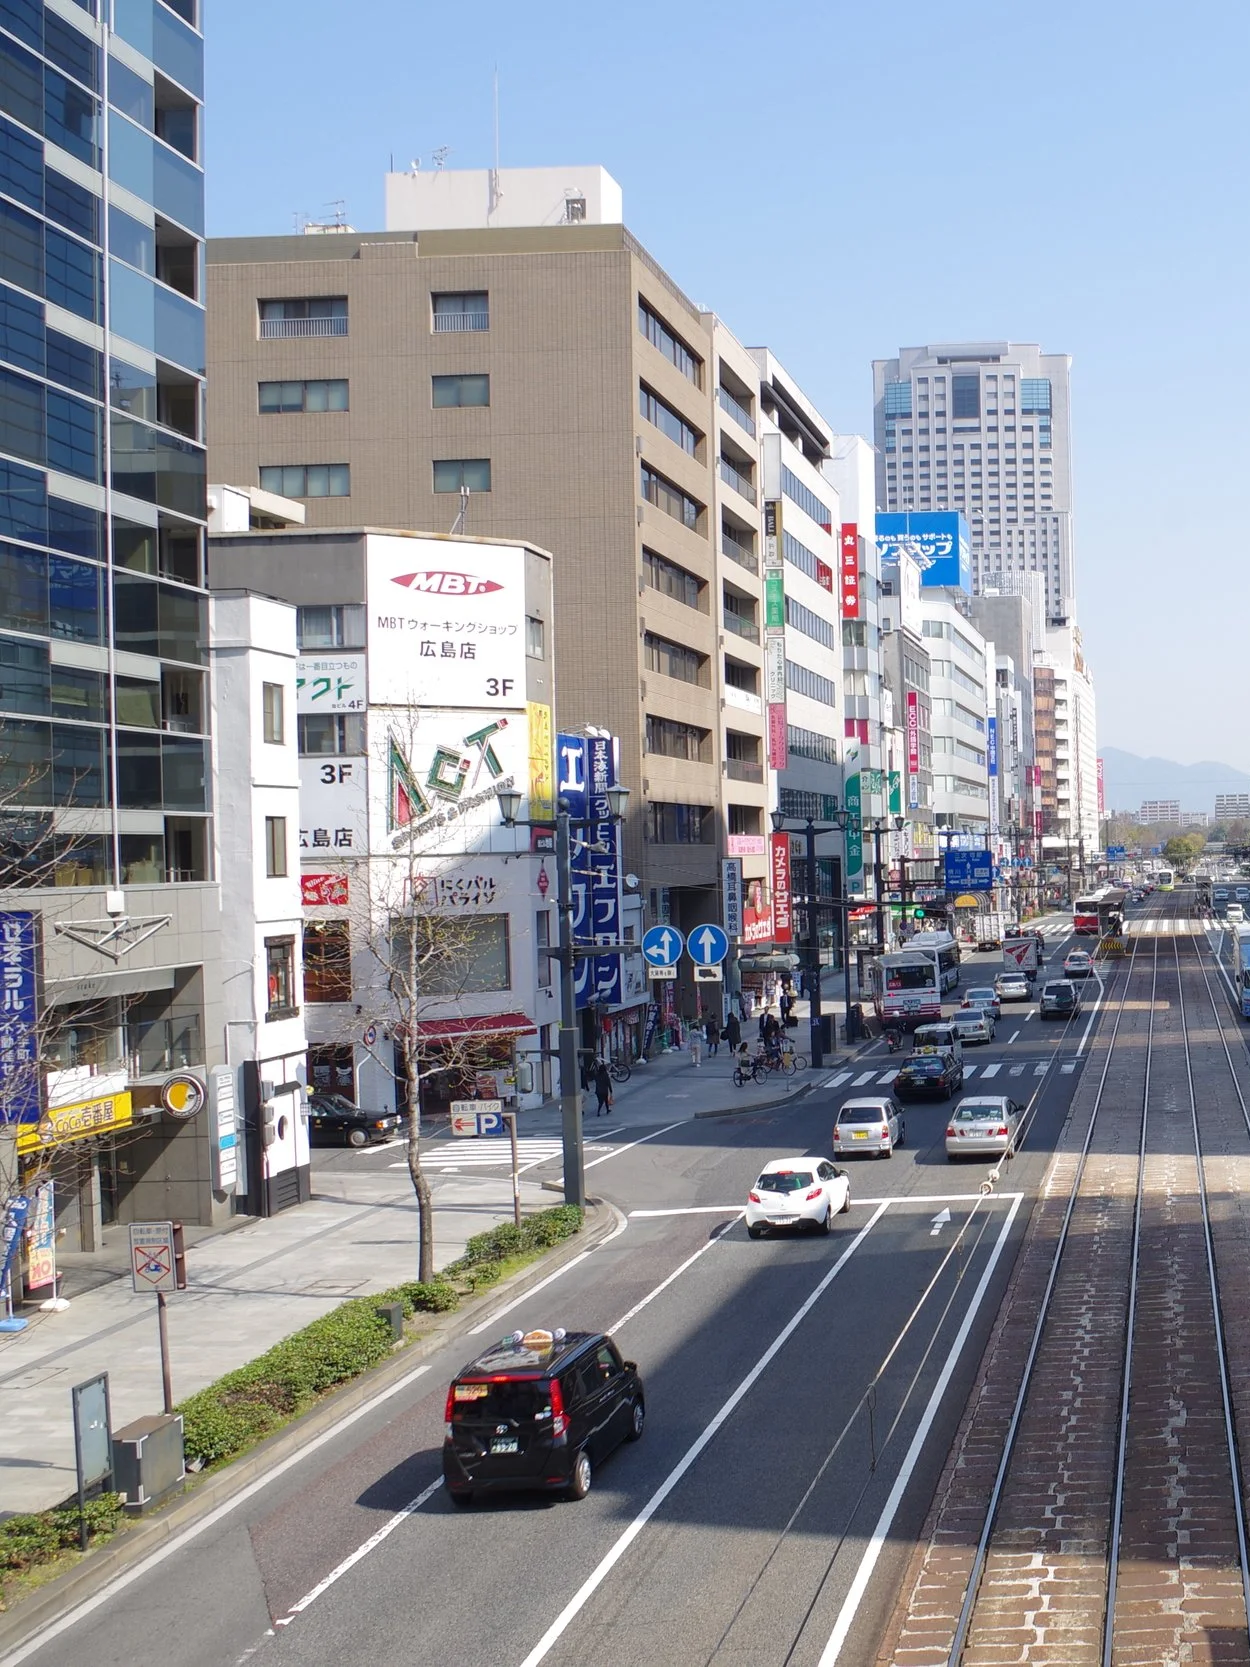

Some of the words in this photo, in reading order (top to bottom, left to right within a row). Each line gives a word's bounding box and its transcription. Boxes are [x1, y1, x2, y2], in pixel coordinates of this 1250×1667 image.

[844, 535, 856, 606] 丸三証券
[407, 572, 481, 594] MBT
[420, 640, 477, 660] 広島店
[486, 678, 514, 697] 3F
[347, 699, 364, 711] 4F
[908, 705, 917, 728] ECC
[320, 763, 353, 784] 3F
[593, 741, 609, 794] 日本海新聞
[440, 876, 497, 891] にくバル
[775, 845, 789, 929] カメラのサエダ
[851, 881, 861, 892] P
[441, 892, 497, 906] パライソ
[726, 862, 738, 933] 高橋耳鼻咽喉科
[3, 920, 26, 1011] ゼネラル
[479, 1114, 498, 1131] P
